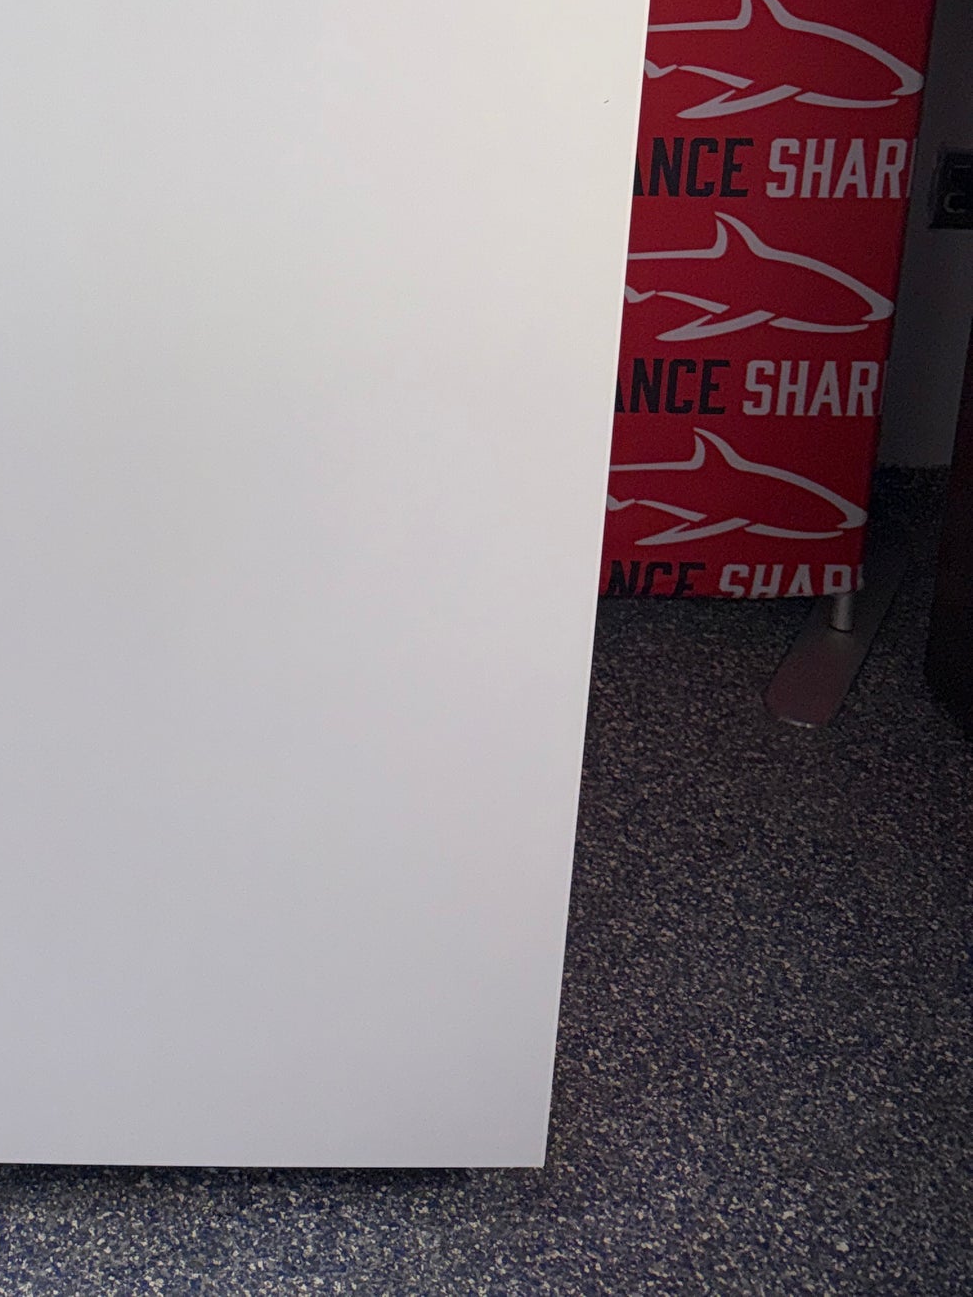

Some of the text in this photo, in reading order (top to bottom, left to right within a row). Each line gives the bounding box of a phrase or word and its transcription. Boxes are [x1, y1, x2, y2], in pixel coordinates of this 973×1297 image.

[633, 137, 917, 199] NCE SHAR
[615, 358, 888, 417] NCE SHAR
